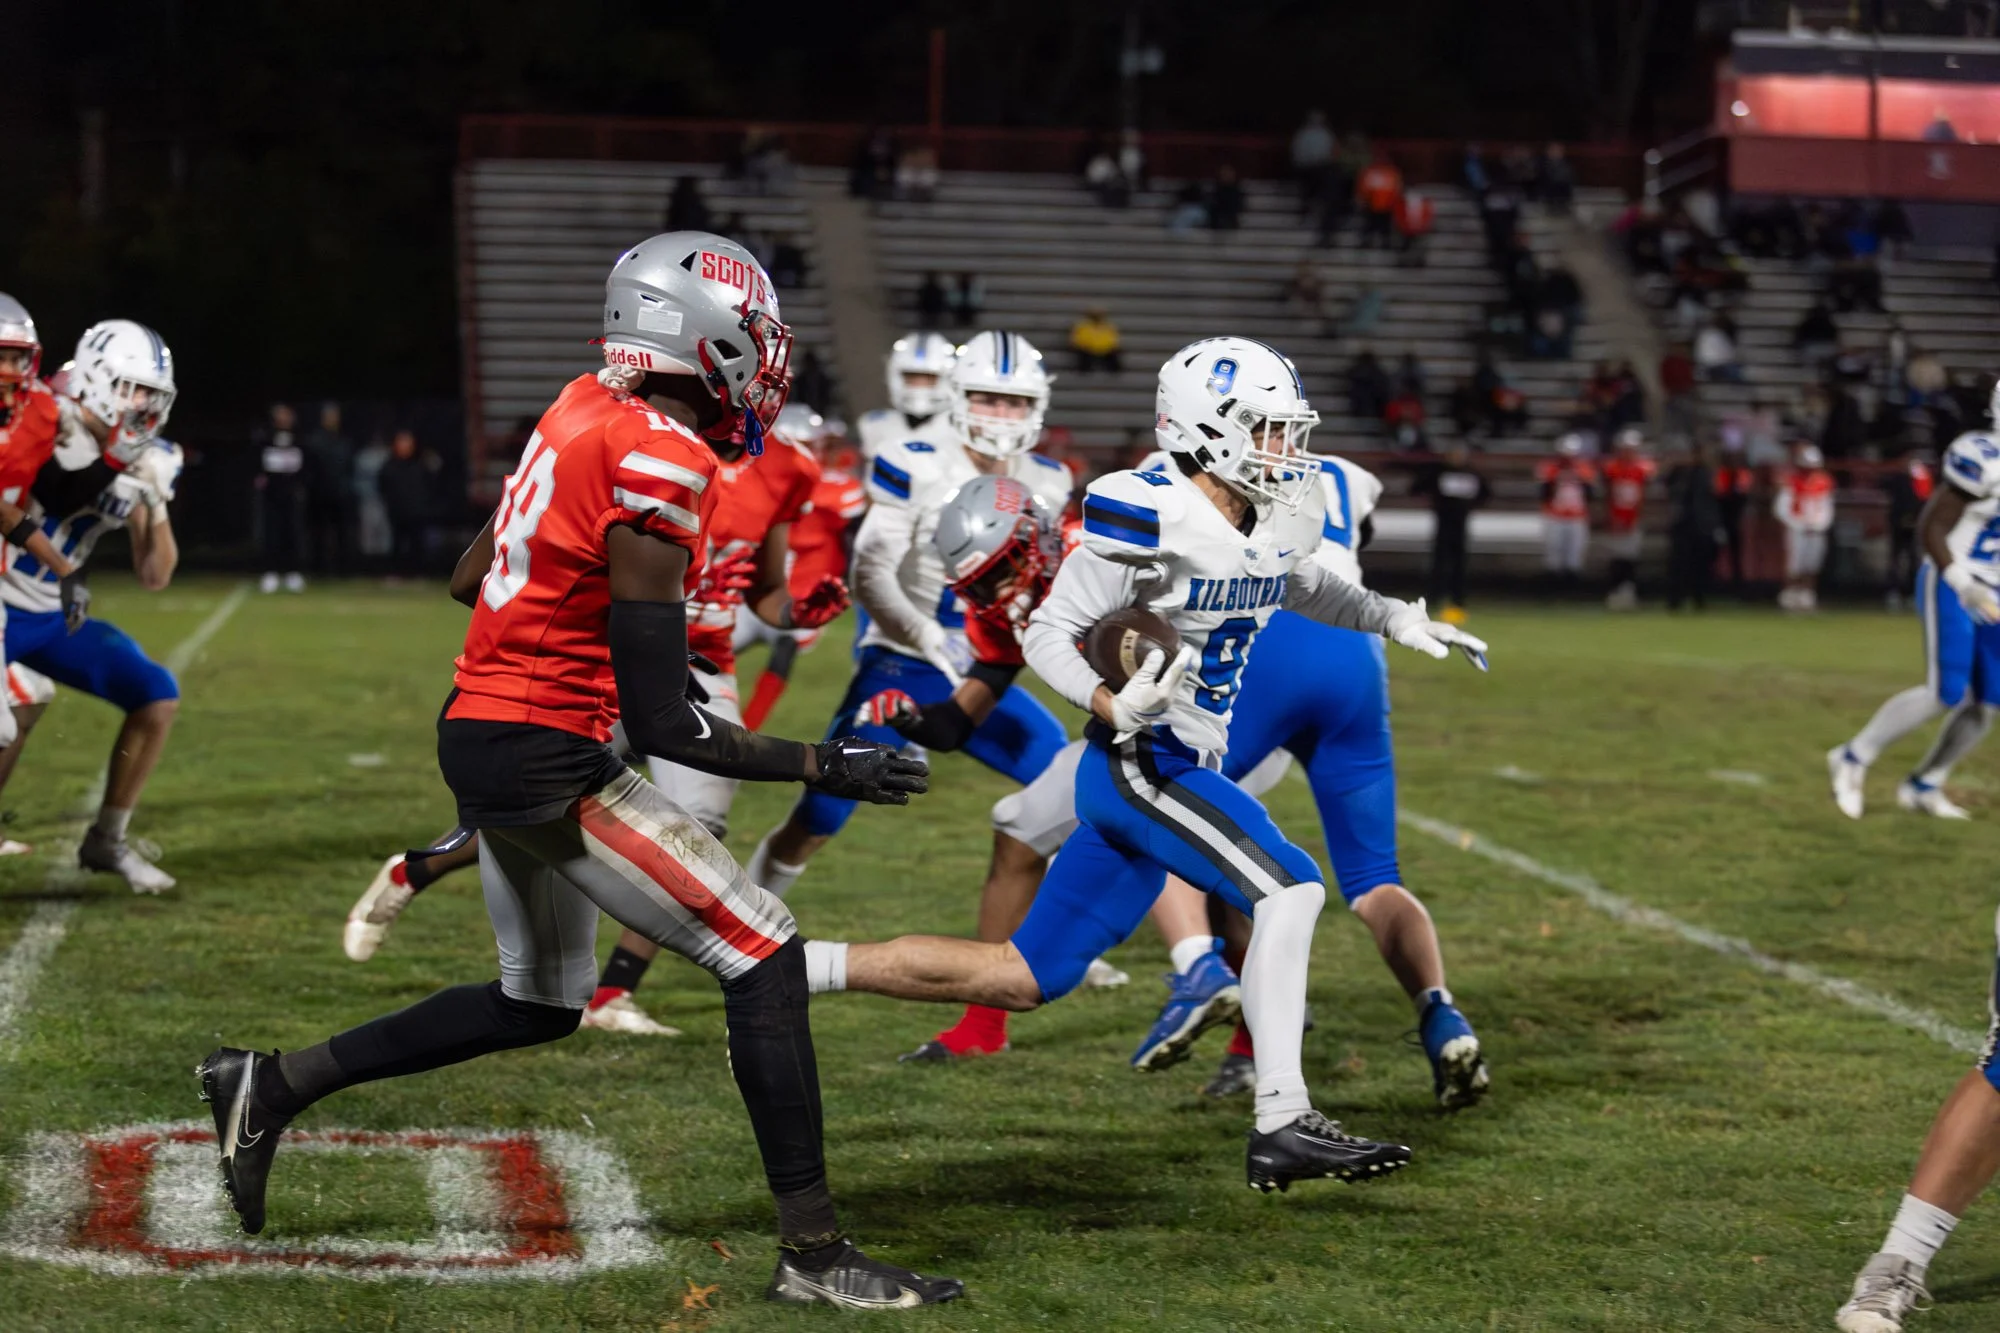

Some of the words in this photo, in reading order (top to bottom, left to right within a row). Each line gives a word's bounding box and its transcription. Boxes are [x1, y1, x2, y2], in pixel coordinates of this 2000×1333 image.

[700, 250, 766, 306] SCOTS
[1205, 356, 1240, 397] 9
[483, 428, 559, 614] 18
[1194, 615, 1259, 716] 9
